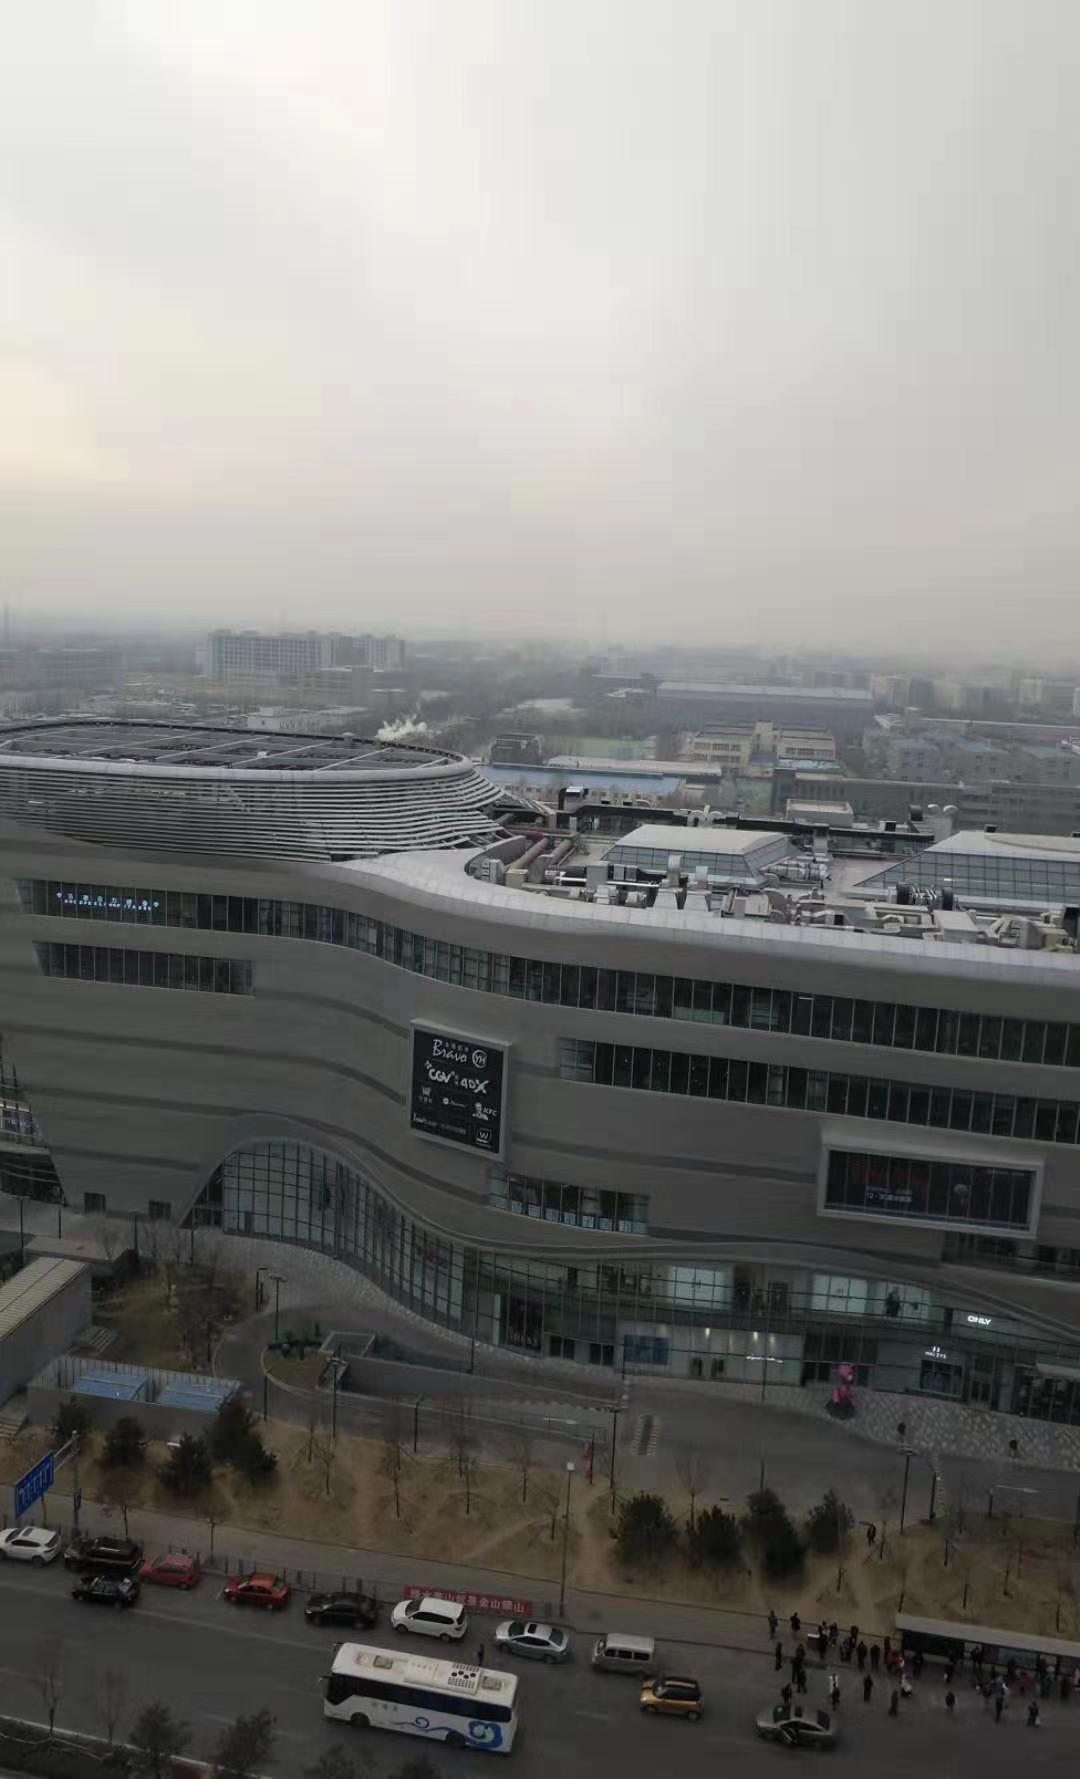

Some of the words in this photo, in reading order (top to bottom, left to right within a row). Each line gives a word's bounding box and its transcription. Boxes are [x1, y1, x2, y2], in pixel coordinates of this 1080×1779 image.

[433, 1038, 468, 1063] Bravo
[428, 1068, 451, 1084] CGV
[460, 1078, 489, 1094] 4DX
[483, 1106, 497, 1117] KFC
[968, 1315, 992, 1326] ONLY
